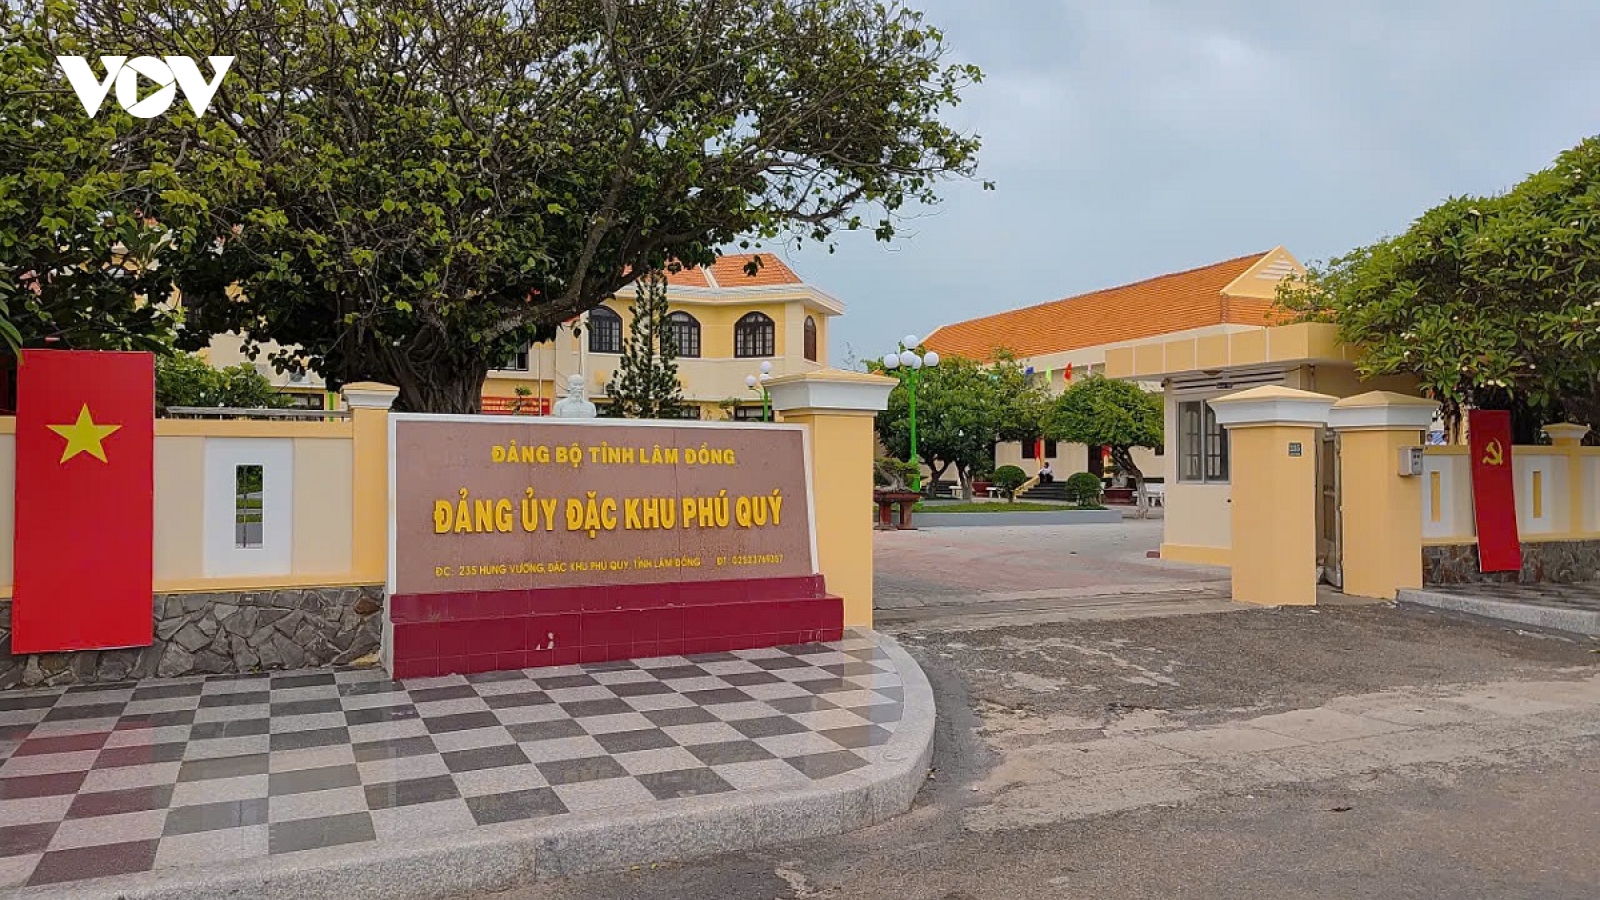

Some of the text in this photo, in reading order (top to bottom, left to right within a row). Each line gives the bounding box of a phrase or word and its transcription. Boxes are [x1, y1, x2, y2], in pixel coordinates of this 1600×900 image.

[491, 439, 736, 468] ĐẢNG BỘ TỈNH LÂM ĐỒNG
[433, 486, 783, 539] ĐẢNG ỦY ĐẶC KHU PHÚ QUÝ
[459, 565, 477, 577] 235
[569, 560, 588, 572] KHU
